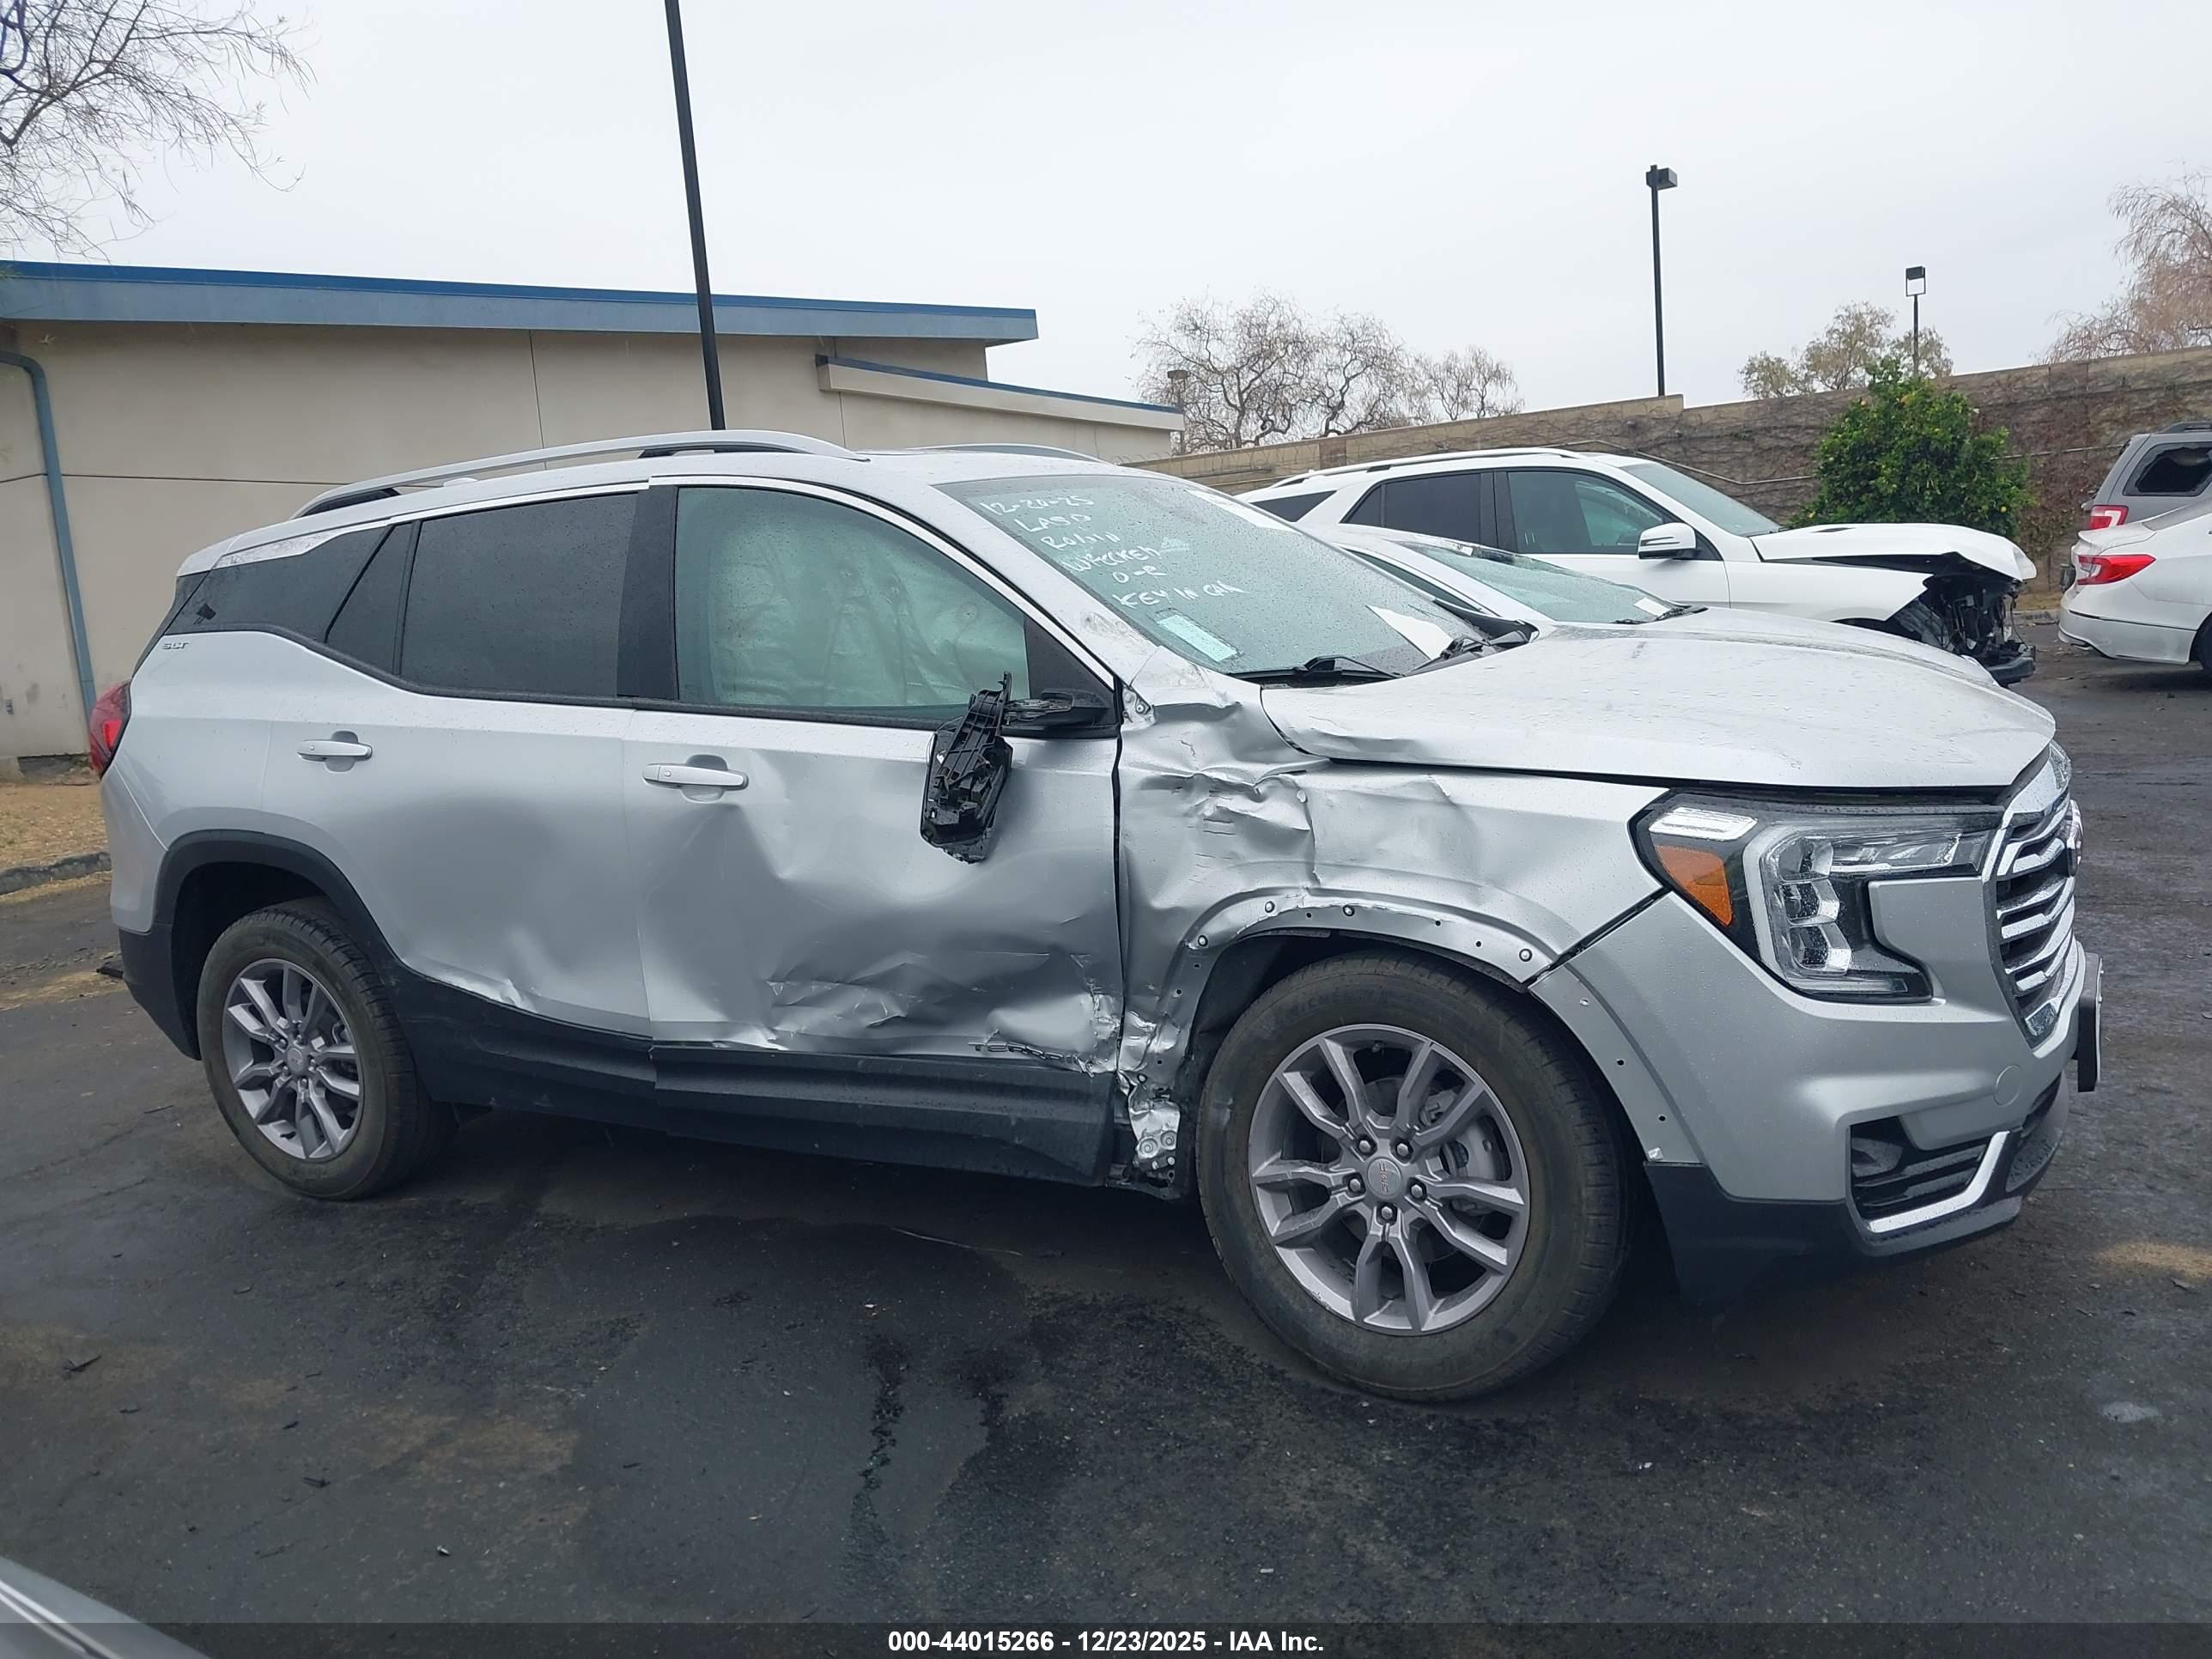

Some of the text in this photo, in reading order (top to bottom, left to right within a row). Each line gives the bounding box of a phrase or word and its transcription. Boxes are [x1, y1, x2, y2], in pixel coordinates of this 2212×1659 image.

[1112, 590, 1172, 609] KEY
[1173, 587, 1199, 600] IN
[161, 641, 190, 650] SLT
